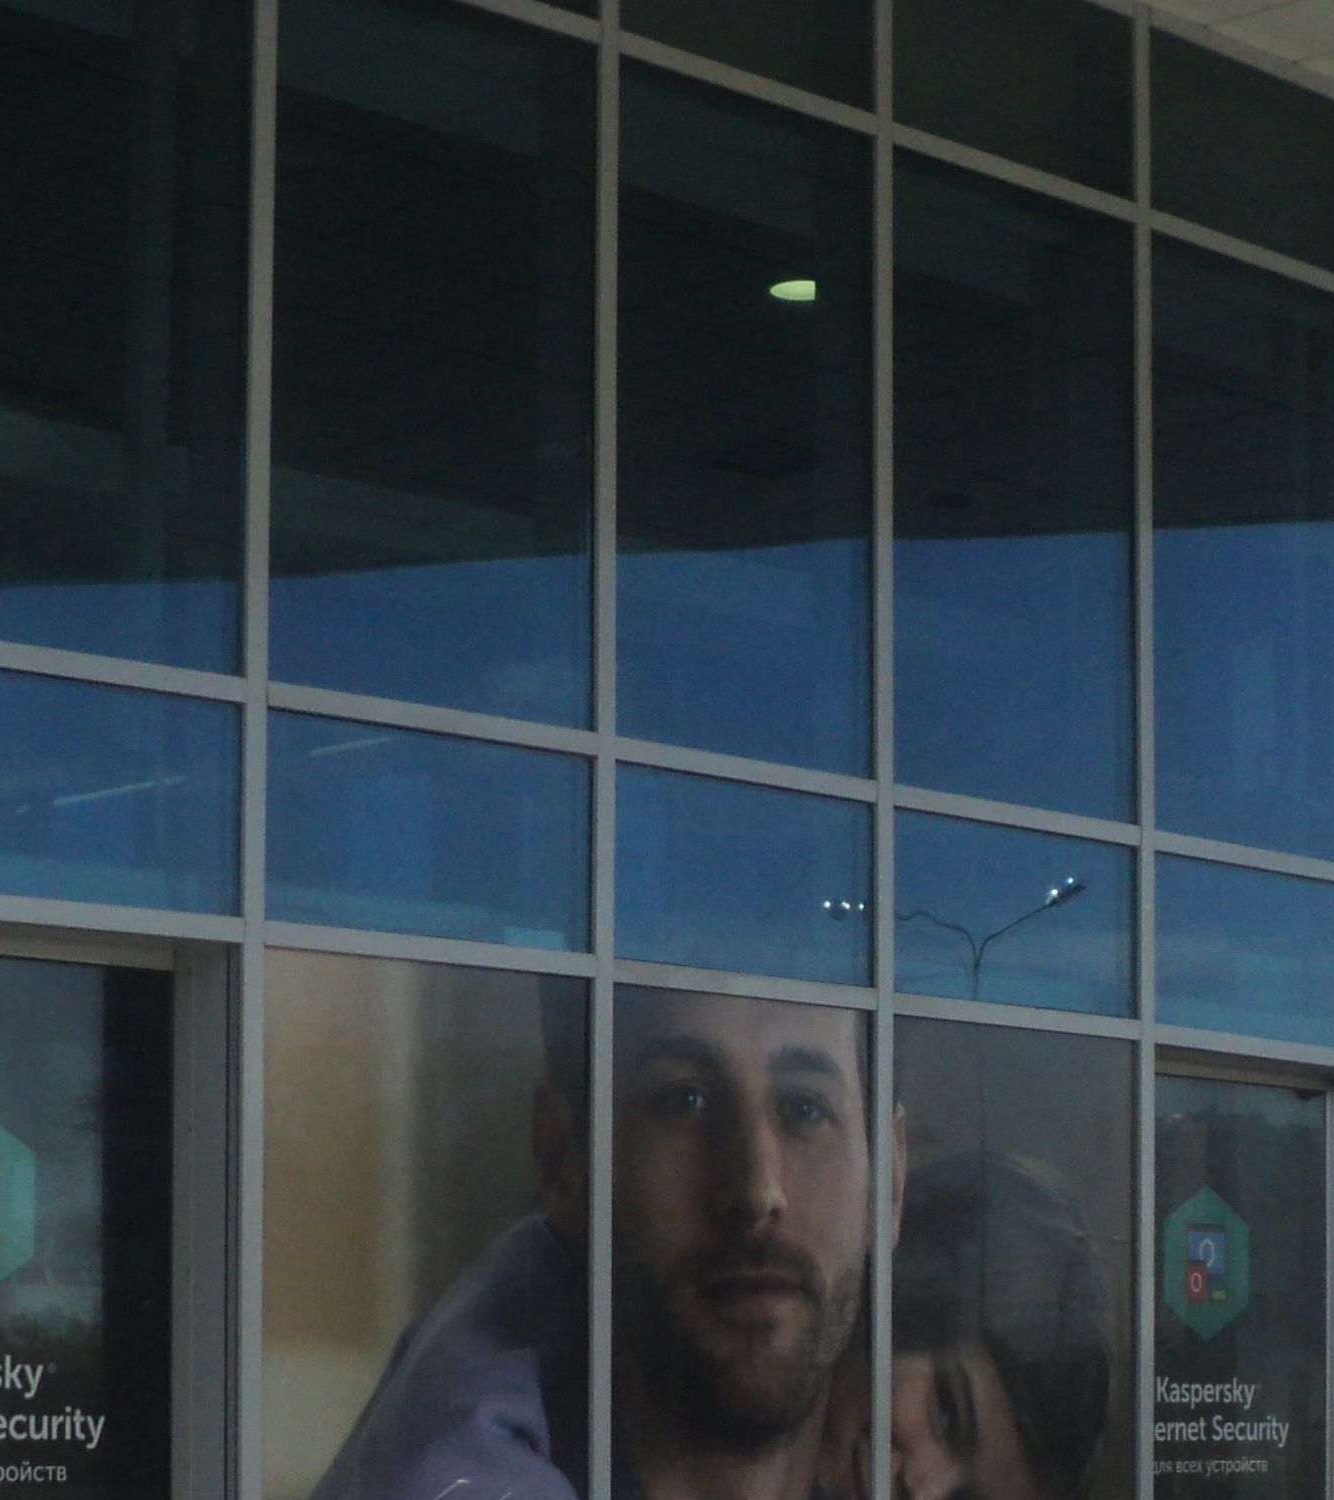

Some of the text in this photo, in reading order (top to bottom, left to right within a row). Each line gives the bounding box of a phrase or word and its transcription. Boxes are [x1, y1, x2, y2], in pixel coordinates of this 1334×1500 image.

[1156, 1376, 1256, 1409] Kaspersky
[1153, 1415, 1289, 1448] ernet Security
